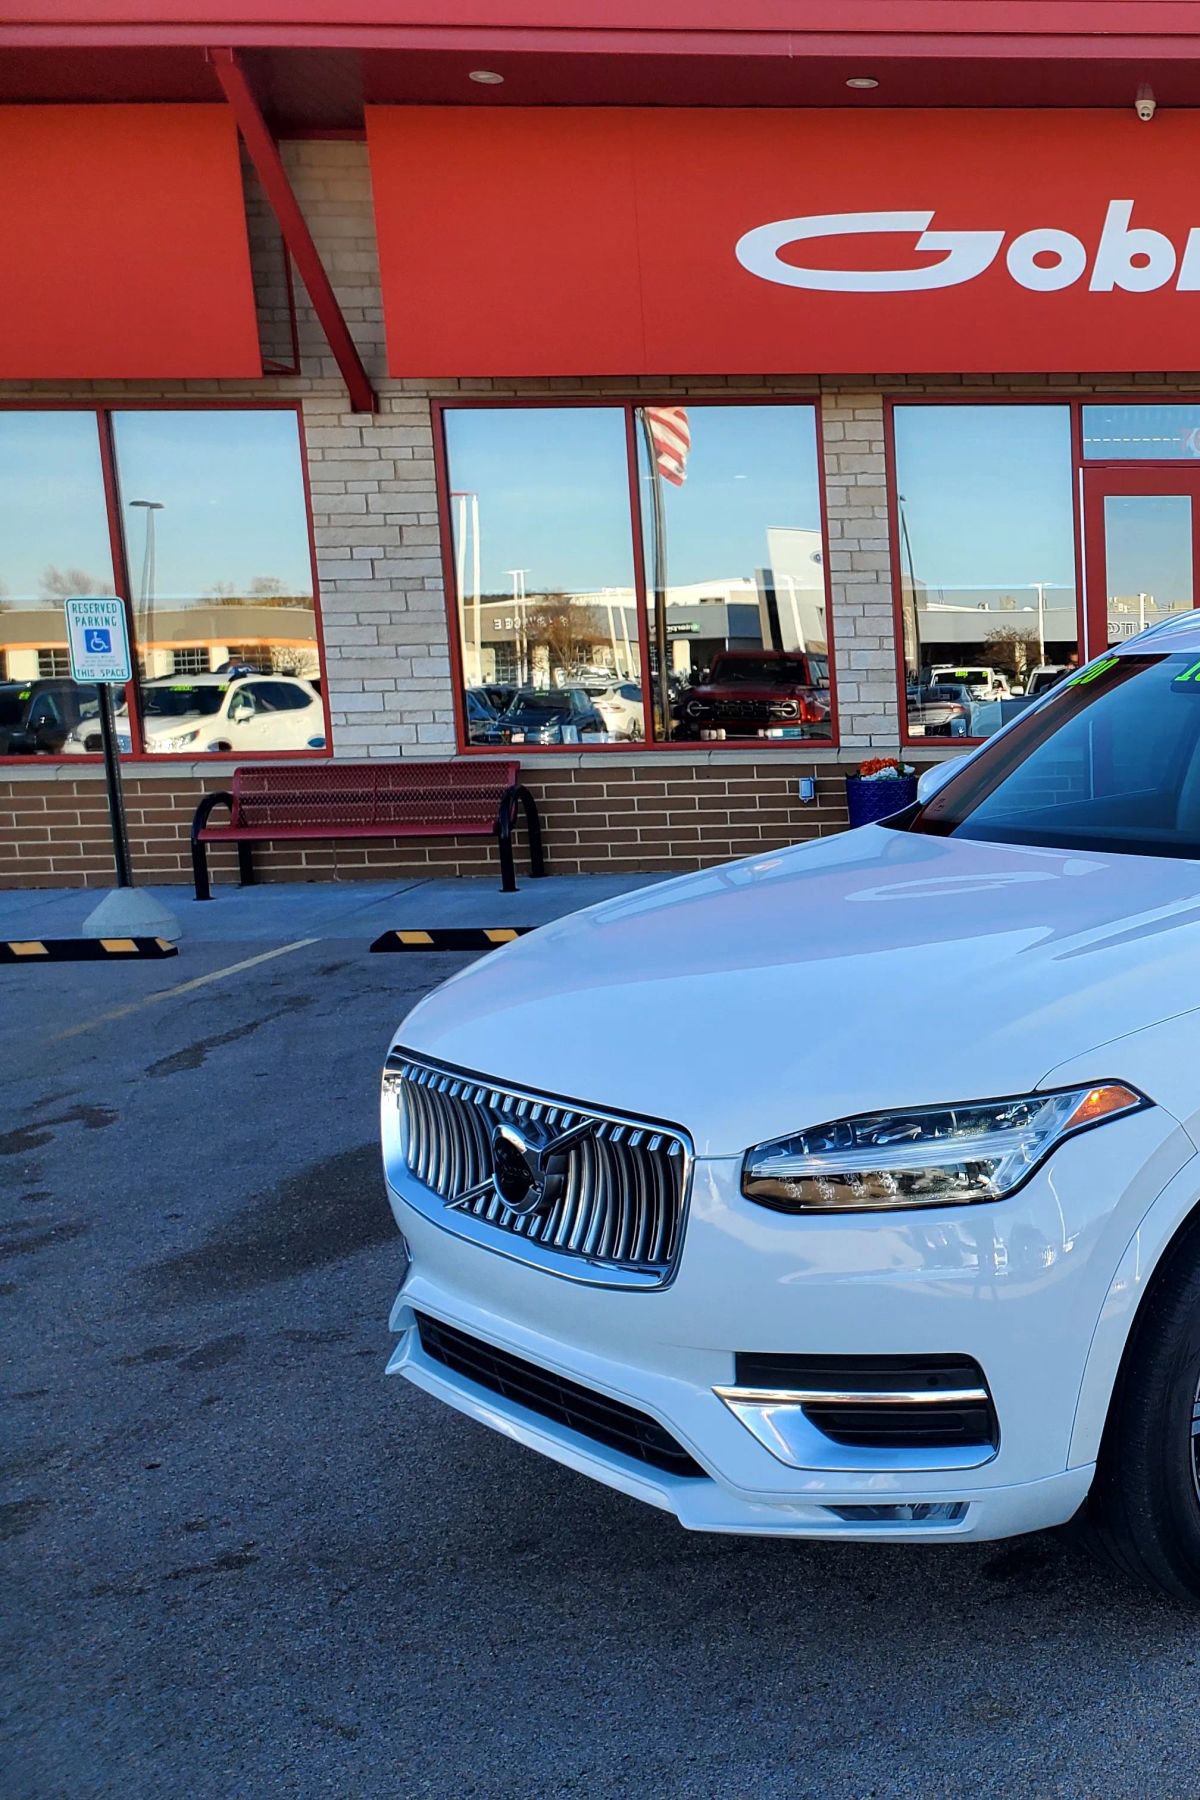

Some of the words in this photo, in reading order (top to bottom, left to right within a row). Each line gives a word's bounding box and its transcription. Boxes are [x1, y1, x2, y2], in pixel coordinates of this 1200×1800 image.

[71, 602, 118, 614] RESERVED
[74, 615, 117, 627] PARKING
[76, 668, 95, 677] THIS
[100, 668, 126, 677] SPACE
